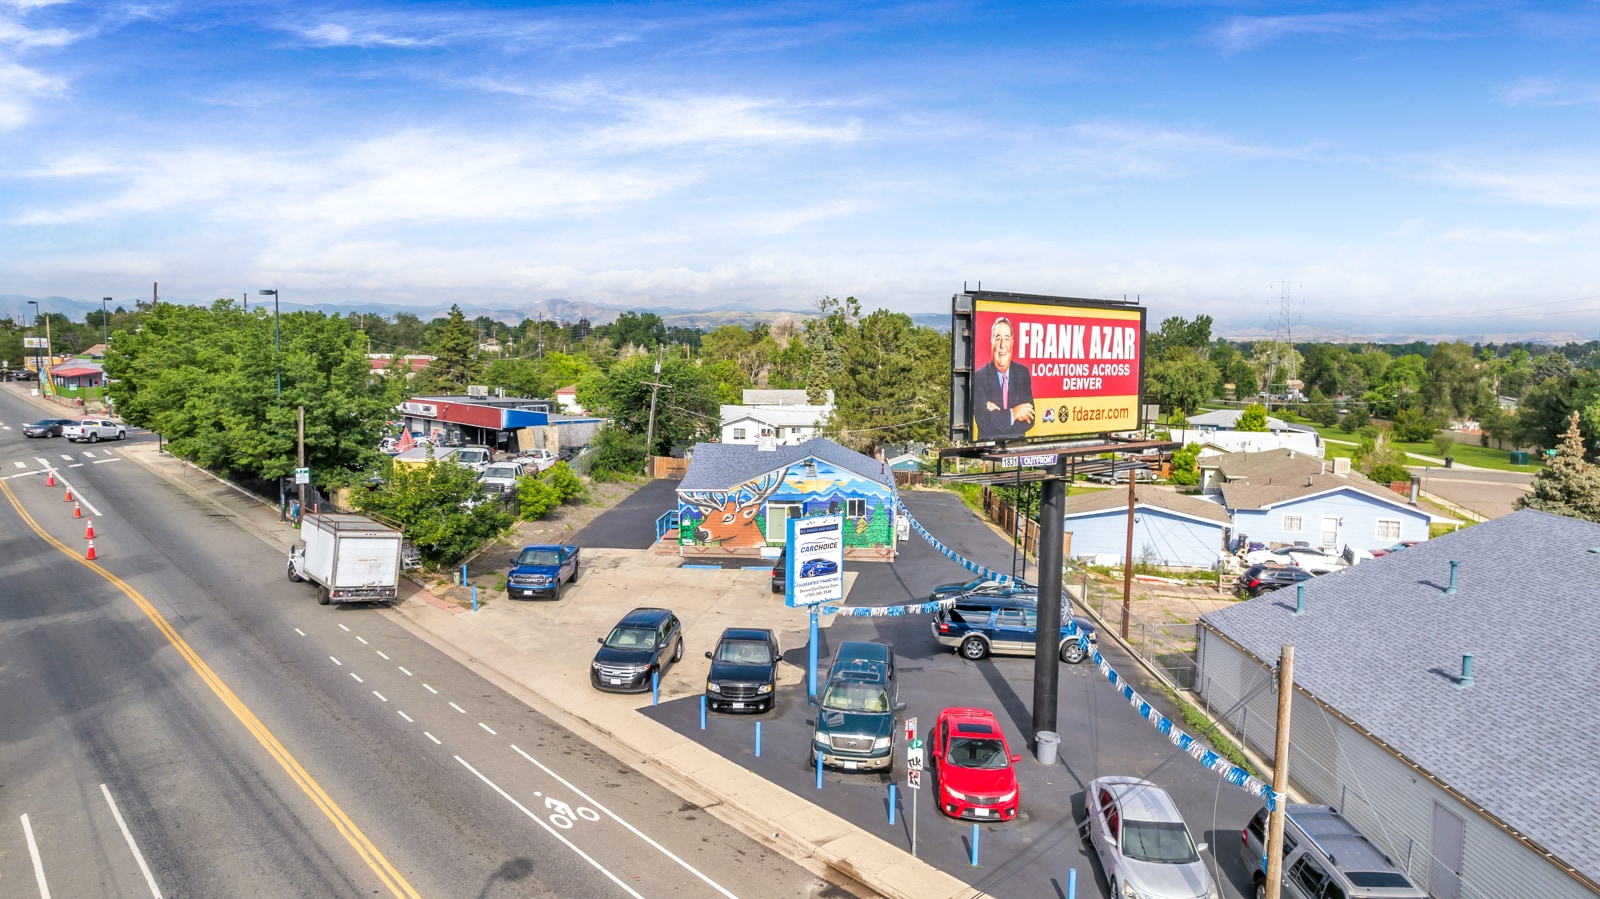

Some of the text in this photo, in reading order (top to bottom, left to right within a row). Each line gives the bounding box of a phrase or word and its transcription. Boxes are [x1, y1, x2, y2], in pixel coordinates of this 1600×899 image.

[1018, 322, 1136, 360] FRANK AZAR
[1031, 363, 1130, 377] LOCATIONS ACROSS
[1062, 377, 1102, 391] DENVER
[1072, 406, 1129, 422] fdazar.com
[1003, 455, 1055, 467] 1831 OUTFRONT
[800, 541, 838, 554] CARCHOICE
